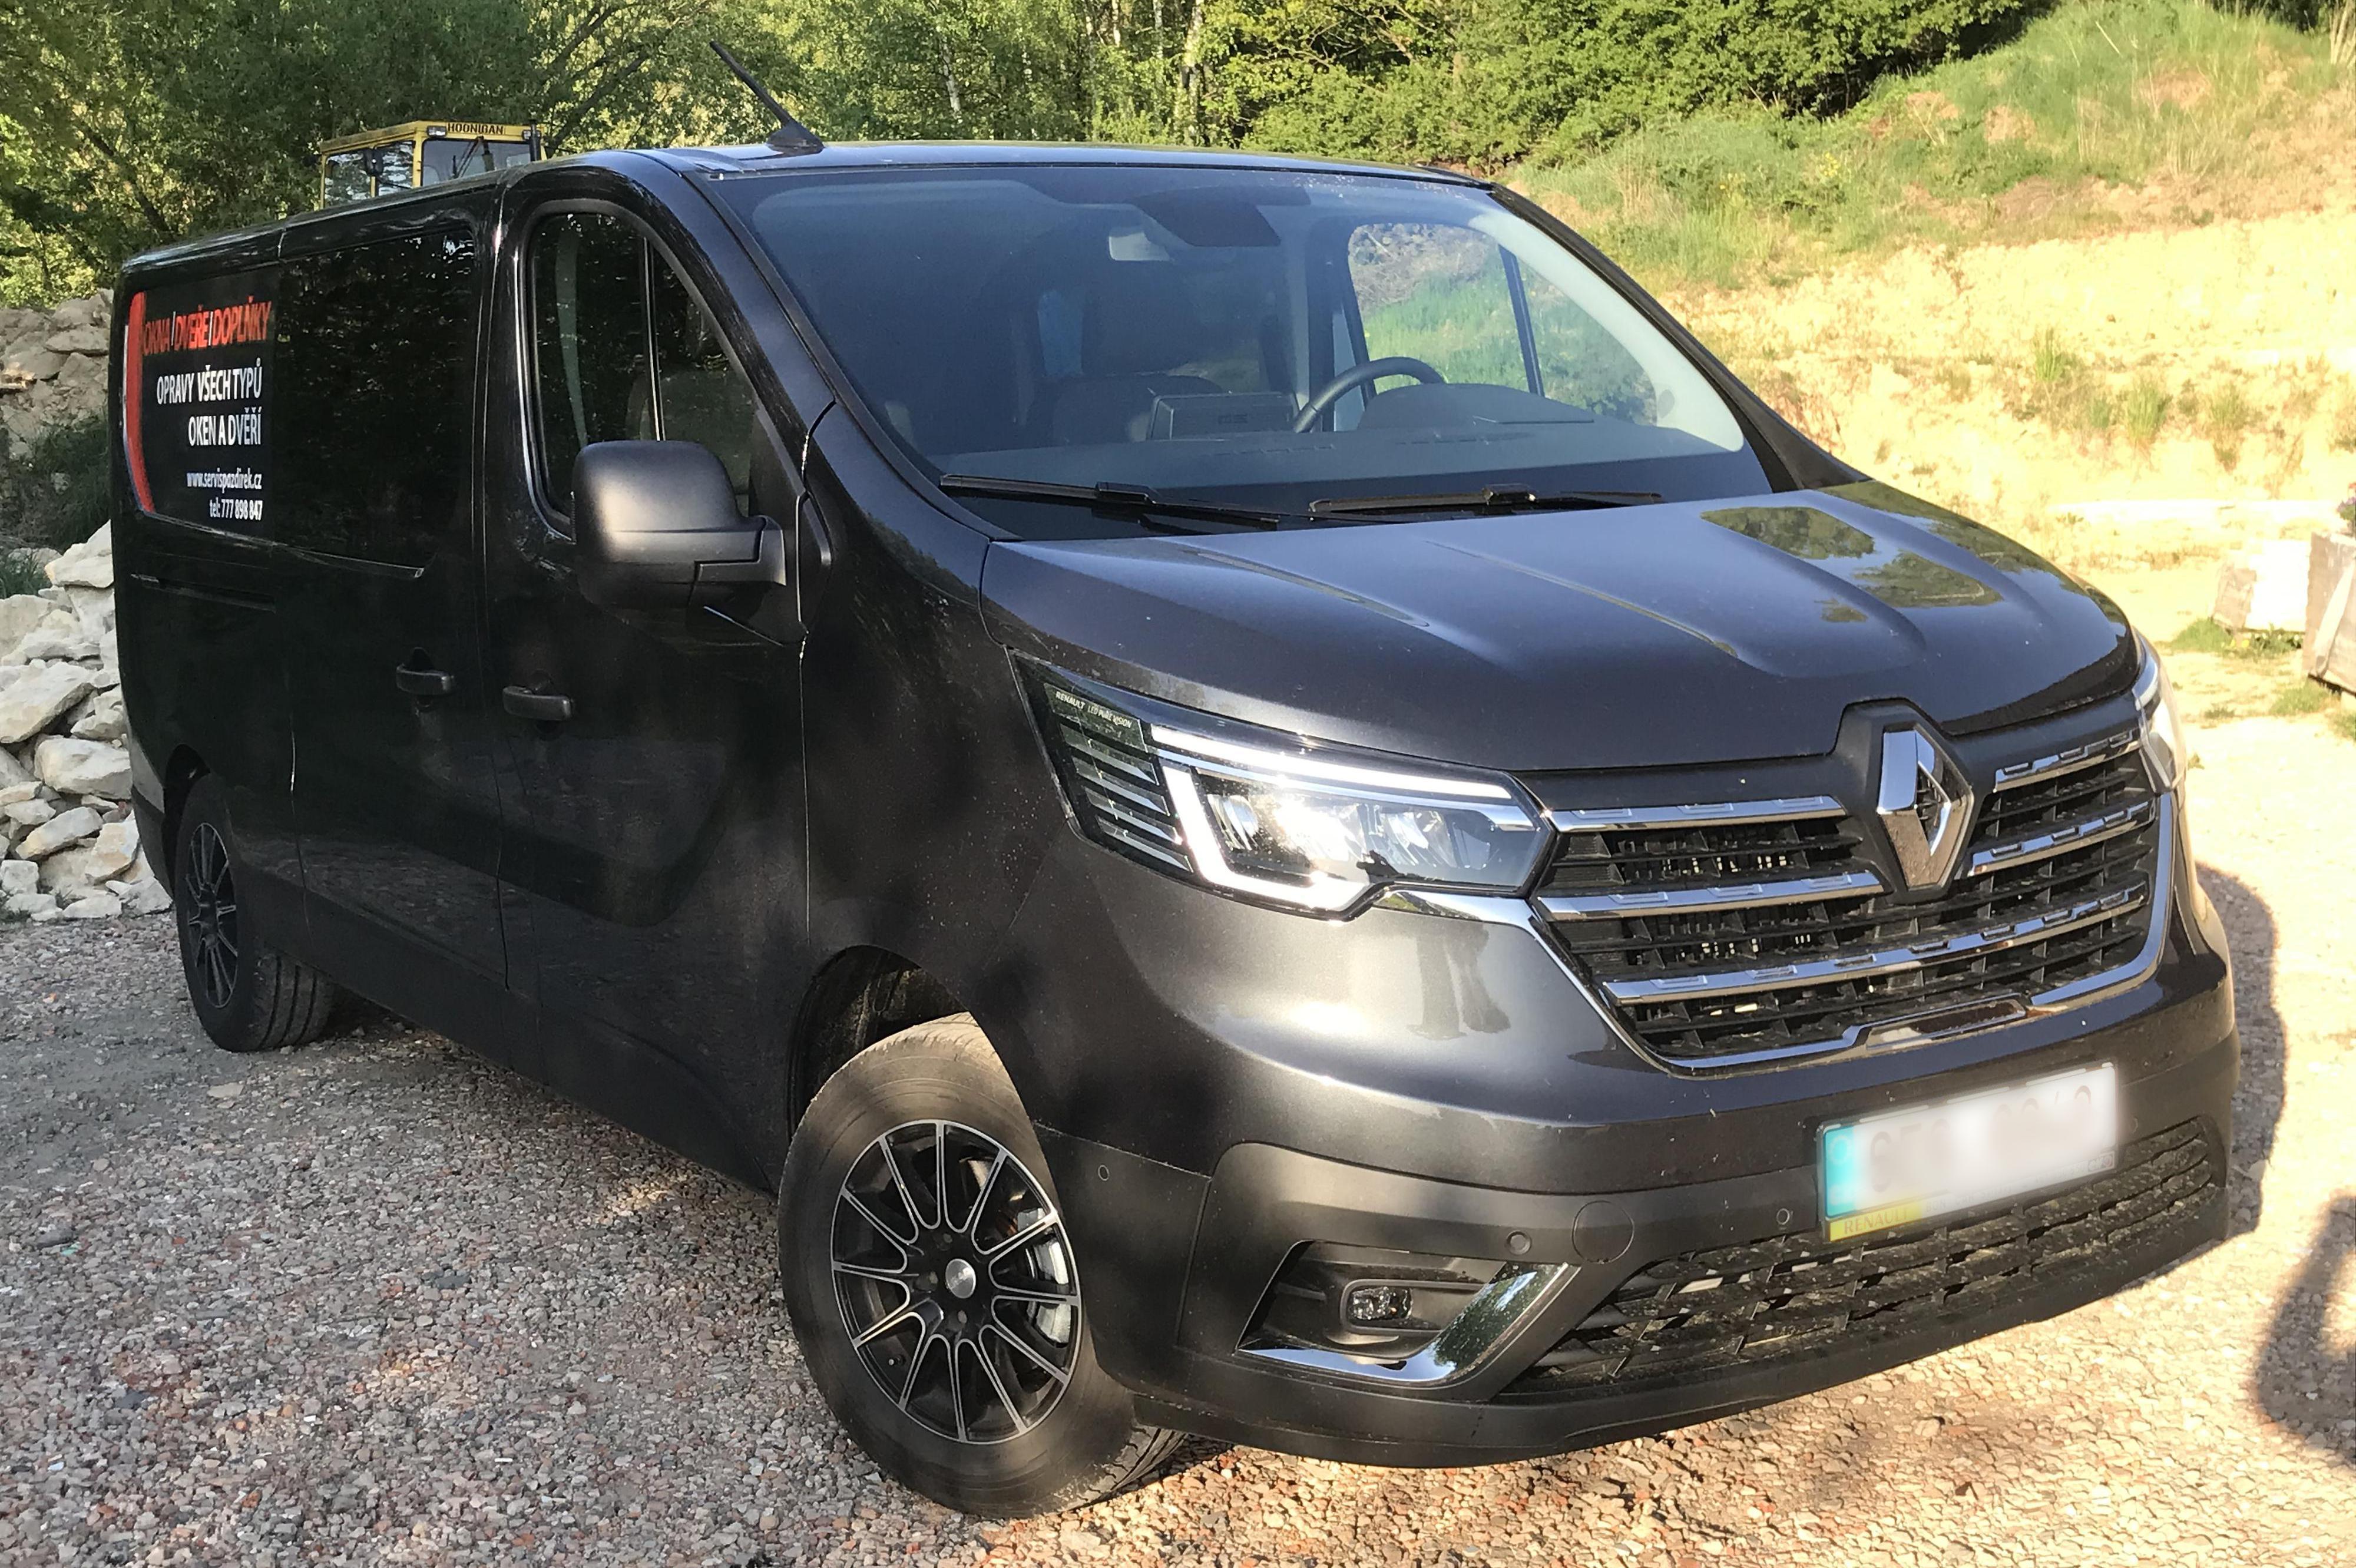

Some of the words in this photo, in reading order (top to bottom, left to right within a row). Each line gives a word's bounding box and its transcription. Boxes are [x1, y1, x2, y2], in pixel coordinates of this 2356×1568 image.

[157, 373, 195, 405] OPRAVY
[197, 364, 231, 402] VŠECH
[233, 357, 263, 399] TYPŮ
[188, 416, 217, 446] OKEN
[218, 415, 227, 446] A
[228, 406, 262, 446] DVĚŘÍ
[221, 499, 234, 518] 777
[235, 499, 249, 520] 898
[249, 499, 263, 521] 847
[1055, 690, 1086, 709] RENAULT
[1087, 704, 1098, 715] LED
[1844, 1208, 1910, 1235] RENAULT
